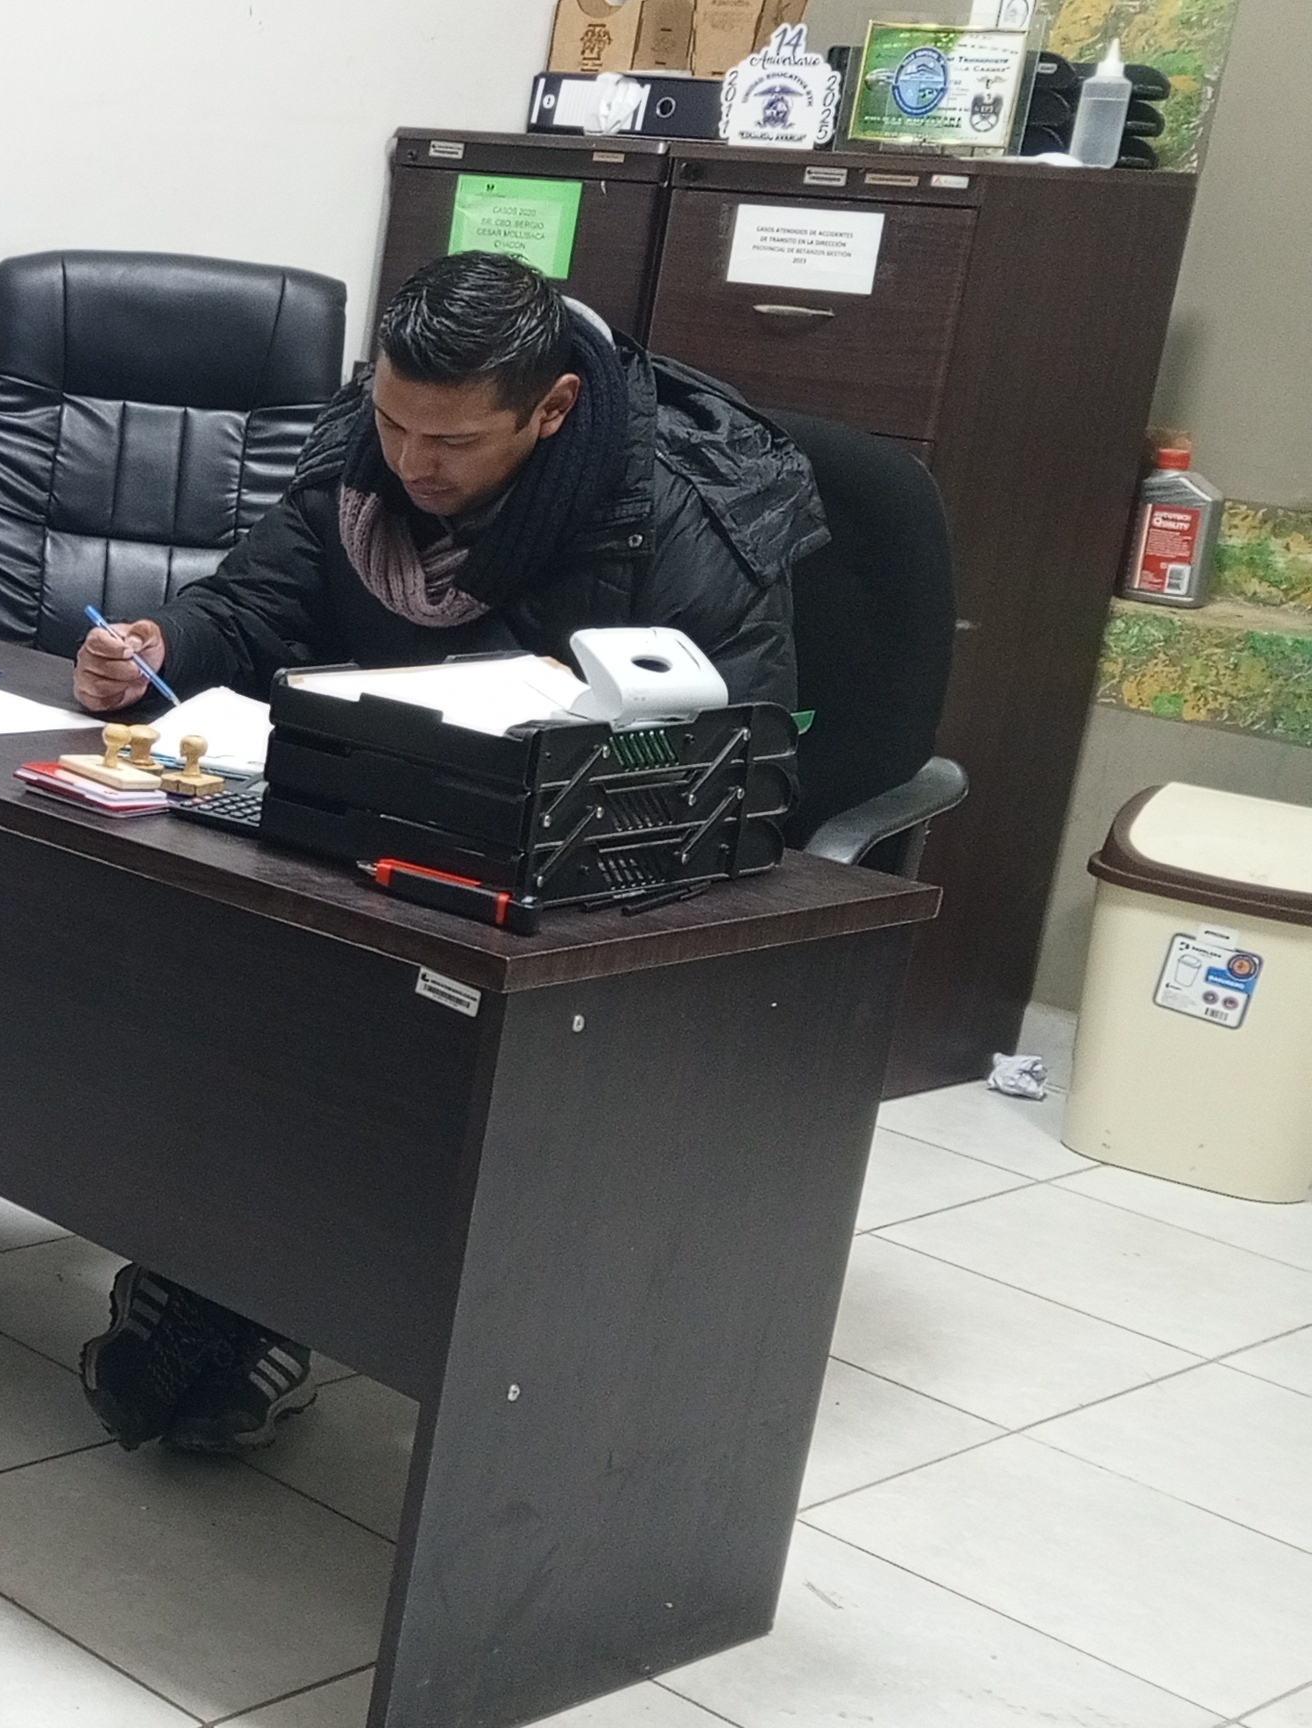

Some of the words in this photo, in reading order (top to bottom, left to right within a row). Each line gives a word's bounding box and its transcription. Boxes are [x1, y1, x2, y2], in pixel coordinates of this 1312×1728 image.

[774, 27, 804, 61] 14
[749, 49, 821, 71] Aniversario
[766, 71, 808, 90] EDUCATIVA
[493, 206, 517, 215] CASOS
[514, 219, 545, 230] SERGIO
[476, 227, 502, 237] CESAR
[756, 225, 775, 233] CASOS
[775, 226, 808, 236] ATENDIDOS
[818, 229, 854, 239] ACCIDENTES
[752, 244, 785, 254] PROVINCIAL
[795, 247, 826, 256] BETANZOS
[826, 249, 852, 258] GESTIÓN
